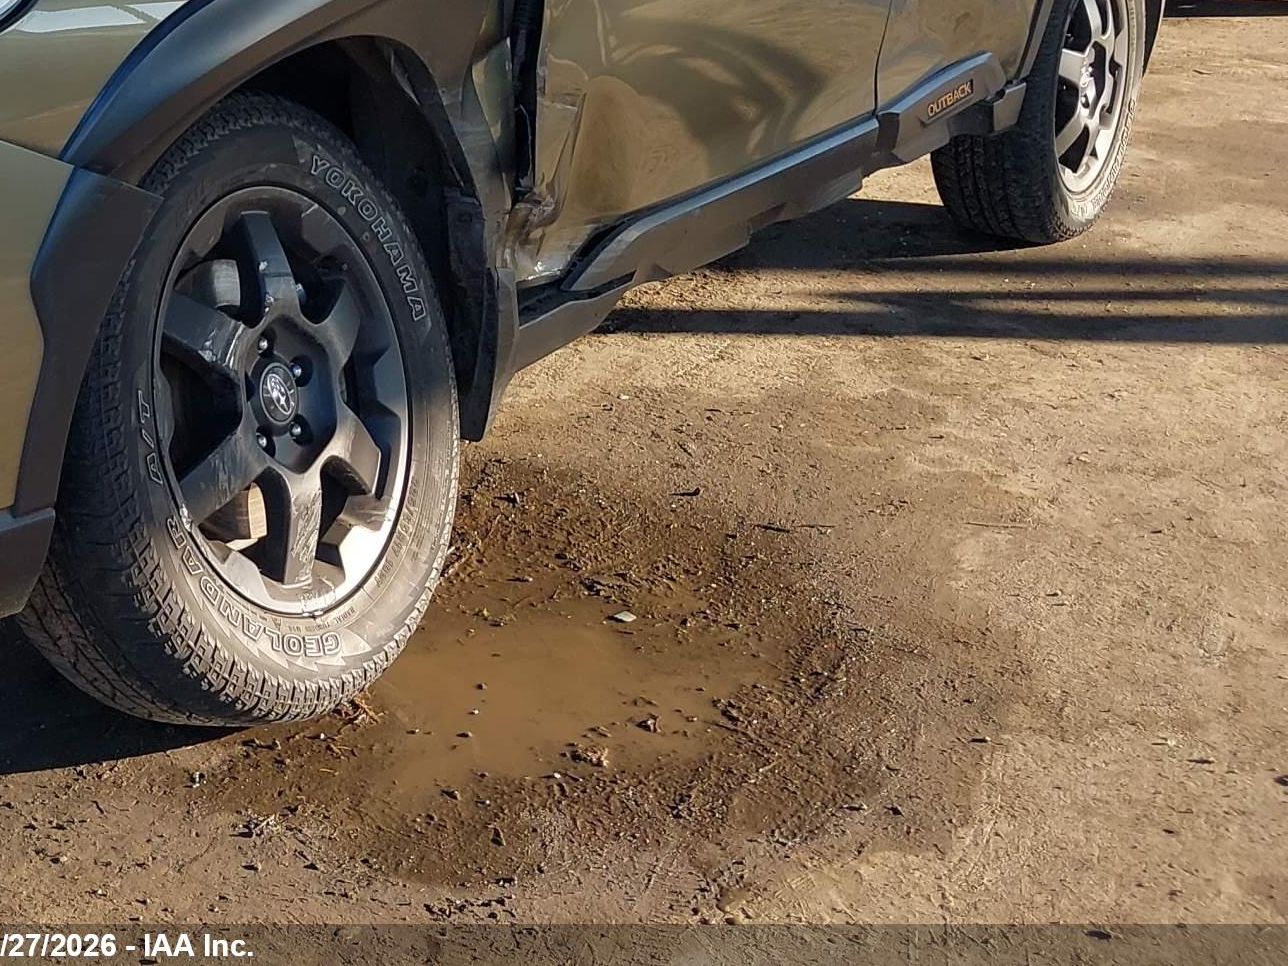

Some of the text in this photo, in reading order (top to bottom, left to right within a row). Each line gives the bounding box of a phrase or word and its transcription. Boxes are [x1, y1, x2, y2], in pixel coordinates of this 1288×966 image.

[927, 81, 972, 117] OUTBACK
[311, 154, 427, 322] YOKOHAMA
[137, 388, 163, 485] A/T
[166, 517, 341, 657] GEOLANDAR
